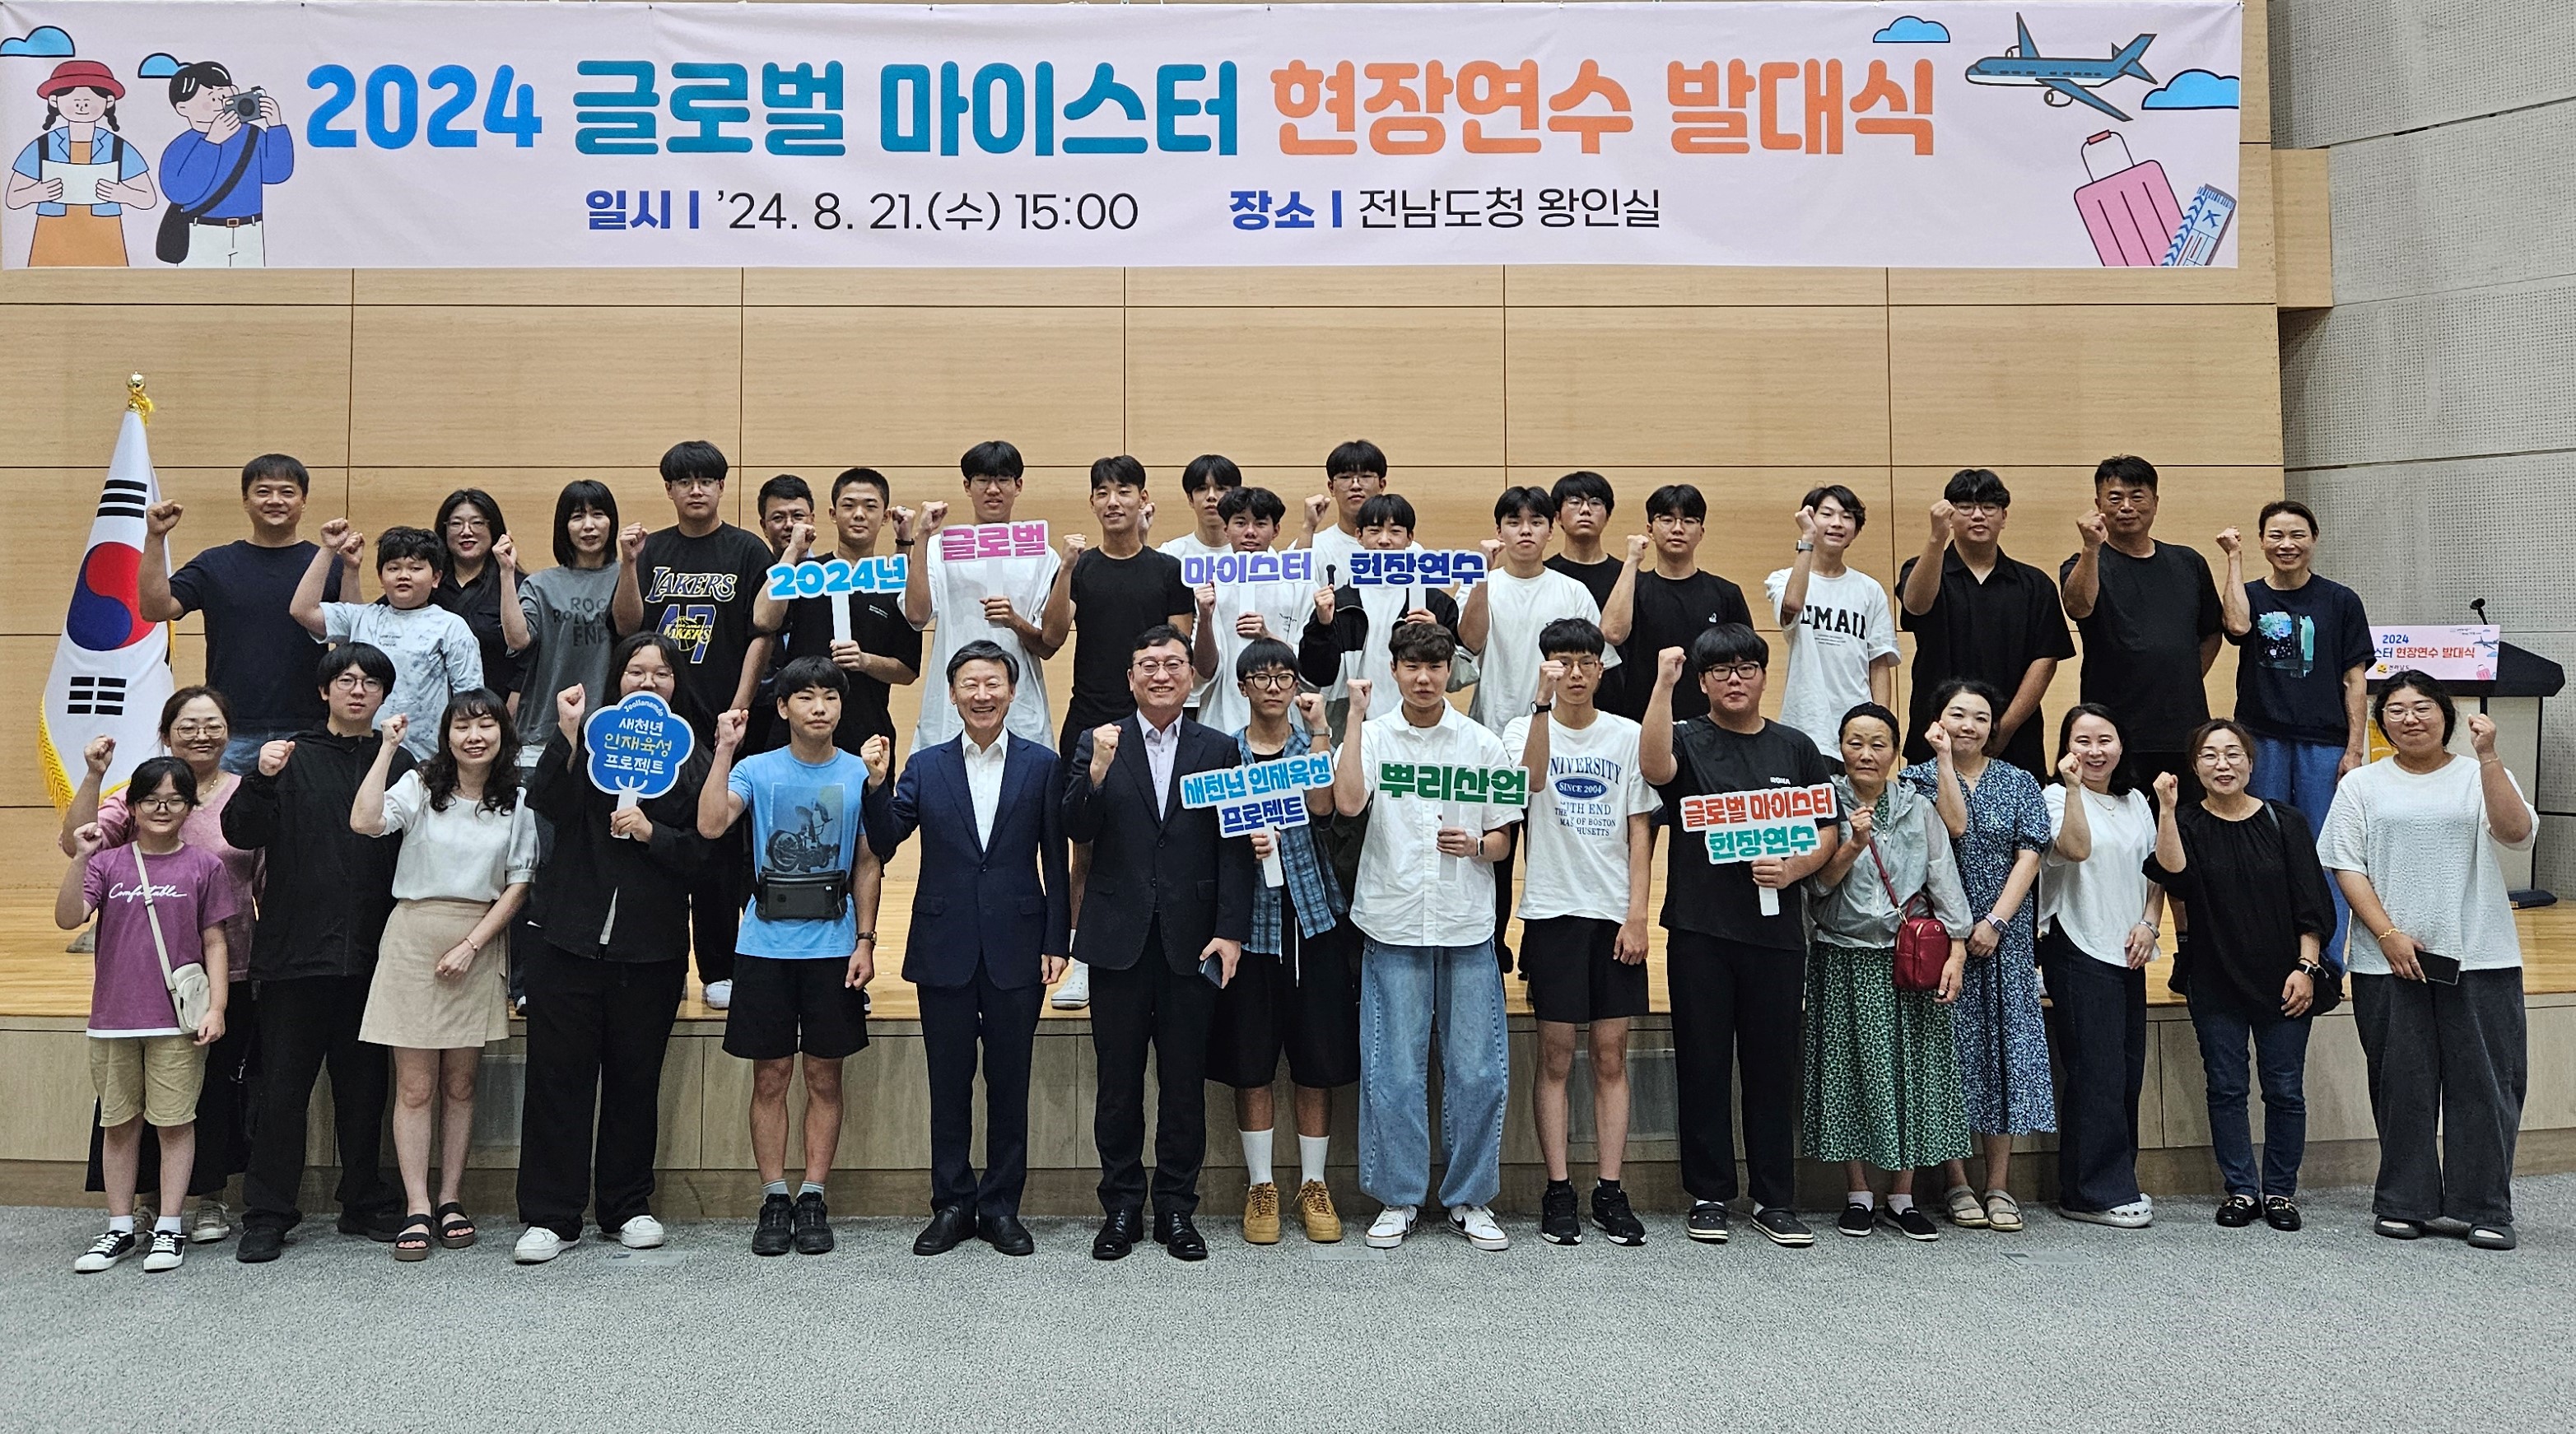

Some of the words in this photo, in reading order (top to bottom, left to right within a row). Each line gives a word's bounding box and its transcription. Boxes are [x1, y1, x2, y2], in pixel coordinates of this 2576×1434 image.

[307, 64, 542, 150] 2024
[573, 61, 845, 156] 글로벌
[881, 61, 1237, 156] 마이스터
[1270, 59, 1633, 155] 현장연수
[1668, 59, 1933, 156] 발대식
[586, 190, 670, 230] 일시
[718, 190, 797, 229] '24.
[814, 193, 853, 230] 8.
[870, 192, 1000, 230] 21.(수)
[1015, 193, 1138, 230] 15:00
[1230, 190, 1314, 230] 장소
[1359, 187, 1523, 228] 전남도청
[1538, 189, 1659, 228] 왕인실
[942, 524, 1046, 561] 글로벌
[771, 556, 906, 596] 2024년
[1185, 552, 1311, 583] 마이스터
[1350, 552, 1484, 585] 현장연수
[645, 566, 738, 603] LAKERS
[571, 597, 608, 612] ROC
[2374, 647, 2392, 658] 스터
[2397, 647, 2439, 658] 현장연수
[2443, 647, 2476, 658] 발대식
[2383, 635, 2409, 644] 2024
[619, 718, 664, 737] 새천년
[604, 733, 673, 757] 인재육성
[603, 753, 664, 775] 프로젝트
[1550, 757, 1622, 785] NIVERSITY
[1184, 770, 1246, 805] 새천년
[1248, 756, 1330, 795] 인재육성
[1380, 763, 1526, 805] 뿌리산업
[1558, 781, 1581, 793] SINCE
[1583, 785, 1603, 794] 2004
[1222, 796, 1306, 833] 프로젝트
[1588, 818, 1616, 827] BOSTON
[1589, 803, 1611, 815] END
[1684, 796, 1747, 828] 글로벌
[1749, 788, 1833, 820] 마이스터
[1709, 826, 1817, 859] 현장연수
[109, 882, 187, 903] Comfotable
